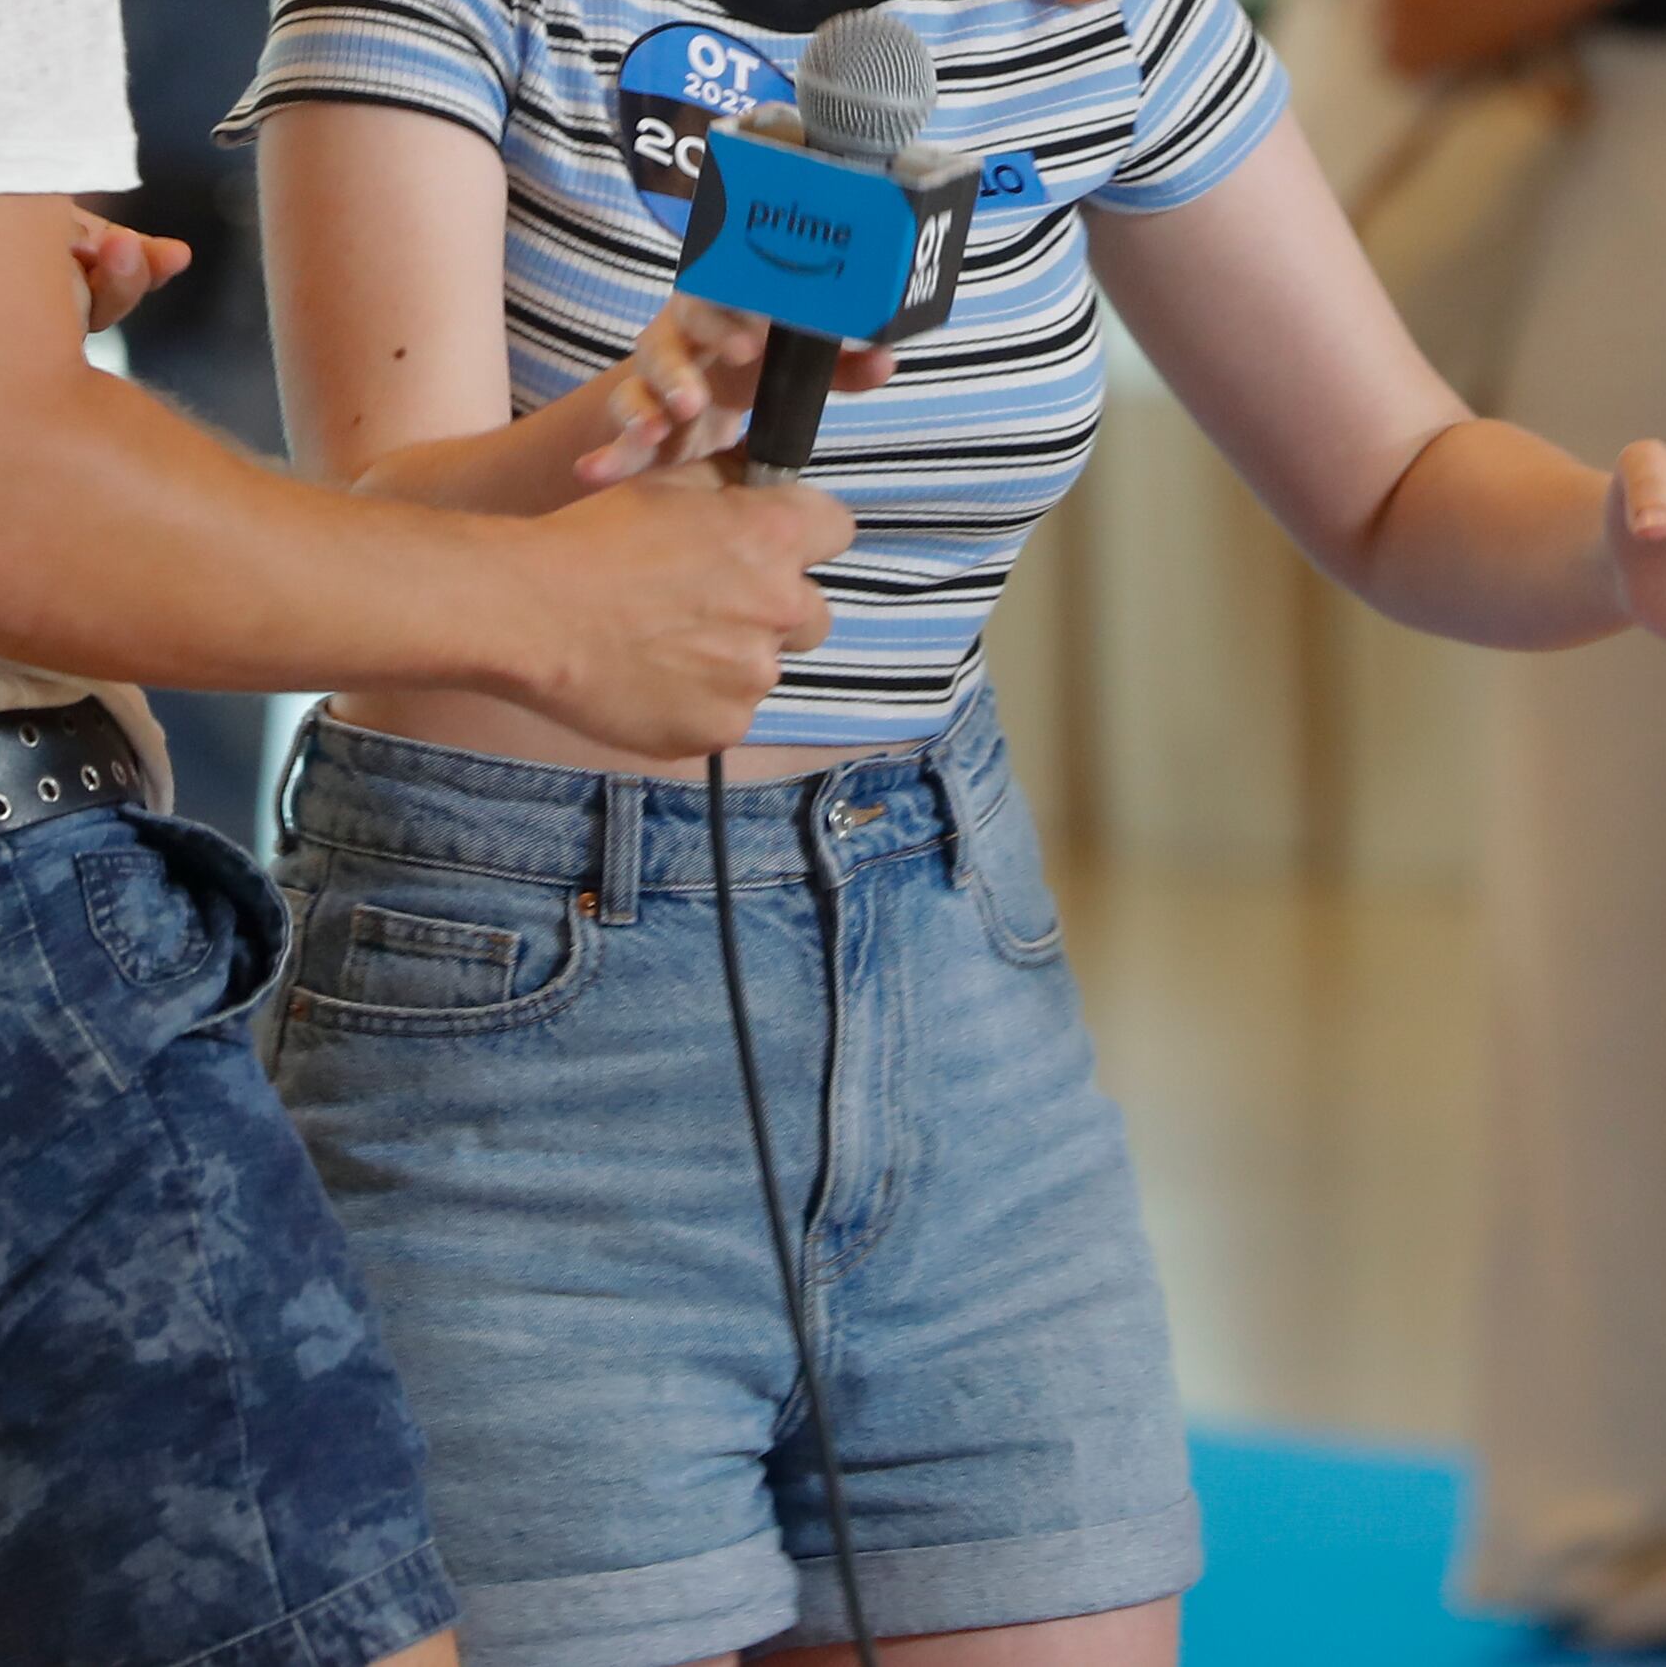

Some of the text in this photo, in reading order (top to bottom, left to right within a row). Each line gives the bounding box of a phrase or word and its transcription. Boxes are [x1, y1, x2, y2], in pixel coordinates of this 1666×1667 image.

[687, 33, 760, 93] OT
[746, 200, 851, 248] prime
[915, 208, 952, 271] OT
